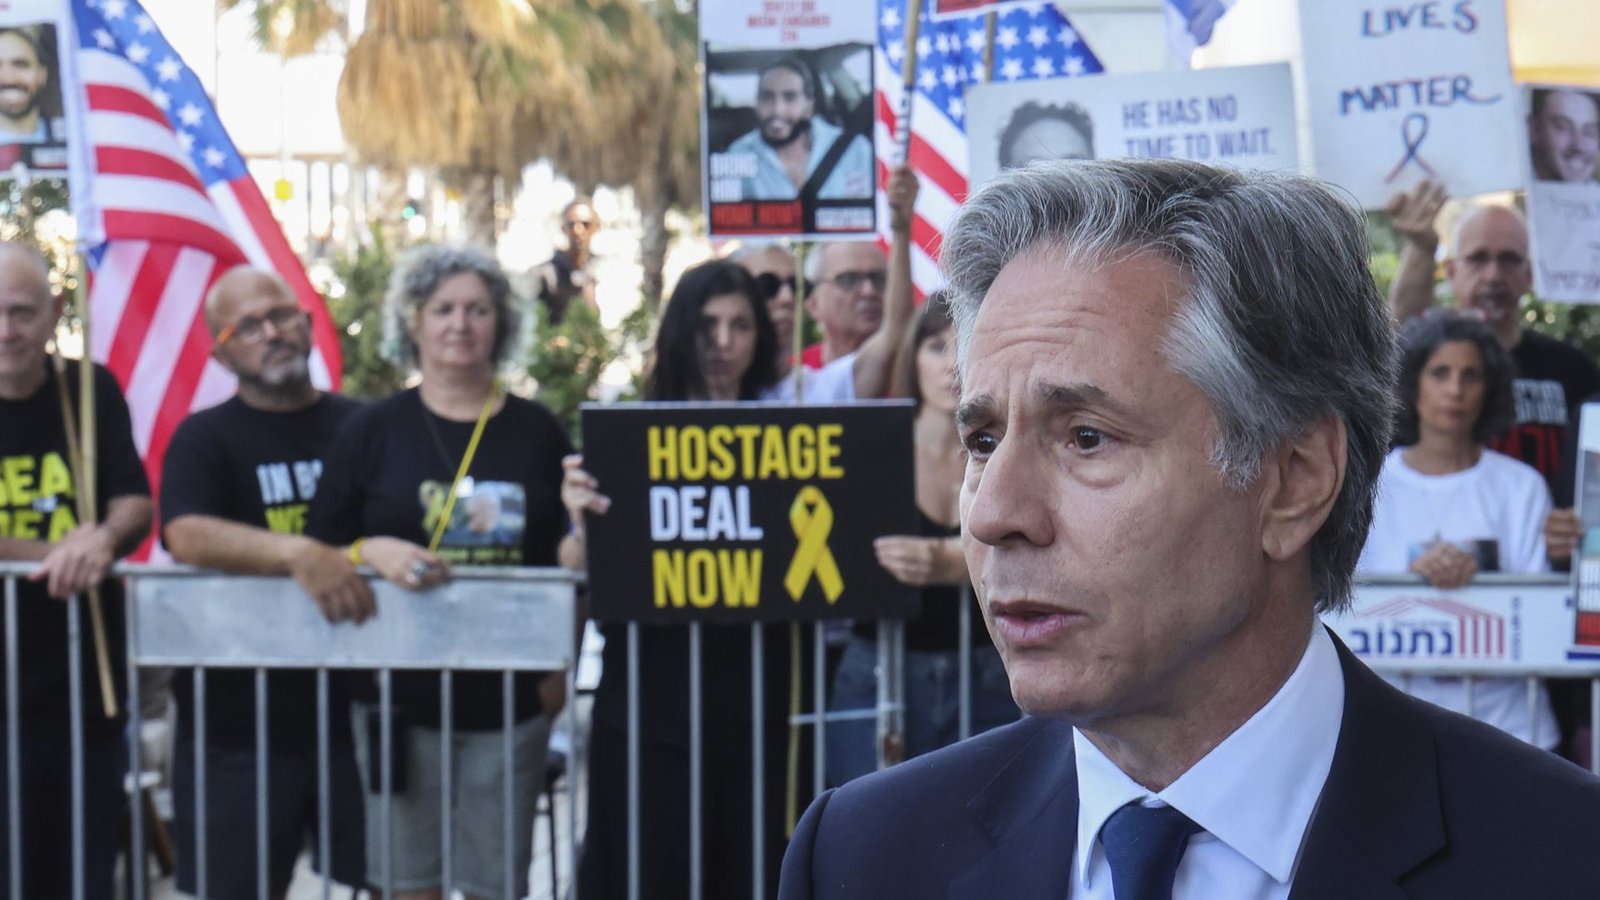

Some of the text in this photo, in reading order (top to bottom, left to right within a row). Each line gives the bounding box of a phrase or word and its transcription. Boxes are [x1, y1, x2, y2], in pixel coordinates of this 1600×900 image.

[1362, 0, 1477, 37] LIVES
[1122, 94, 1237, 129] HE HAS NO
[1340, 74, 1502, 115] MATTER
[1125, 136, 1174, 158] TIME
[1184, 134, 1210, 159] TO
[647, 424, 844, 481] HOSTAGE
[256, 462, 294, 504] IN
[649, 485, 764, 541] DEAL
[652, 548, 764, 608] NOW
[1350, 624, 1455, 656] נתנוב
